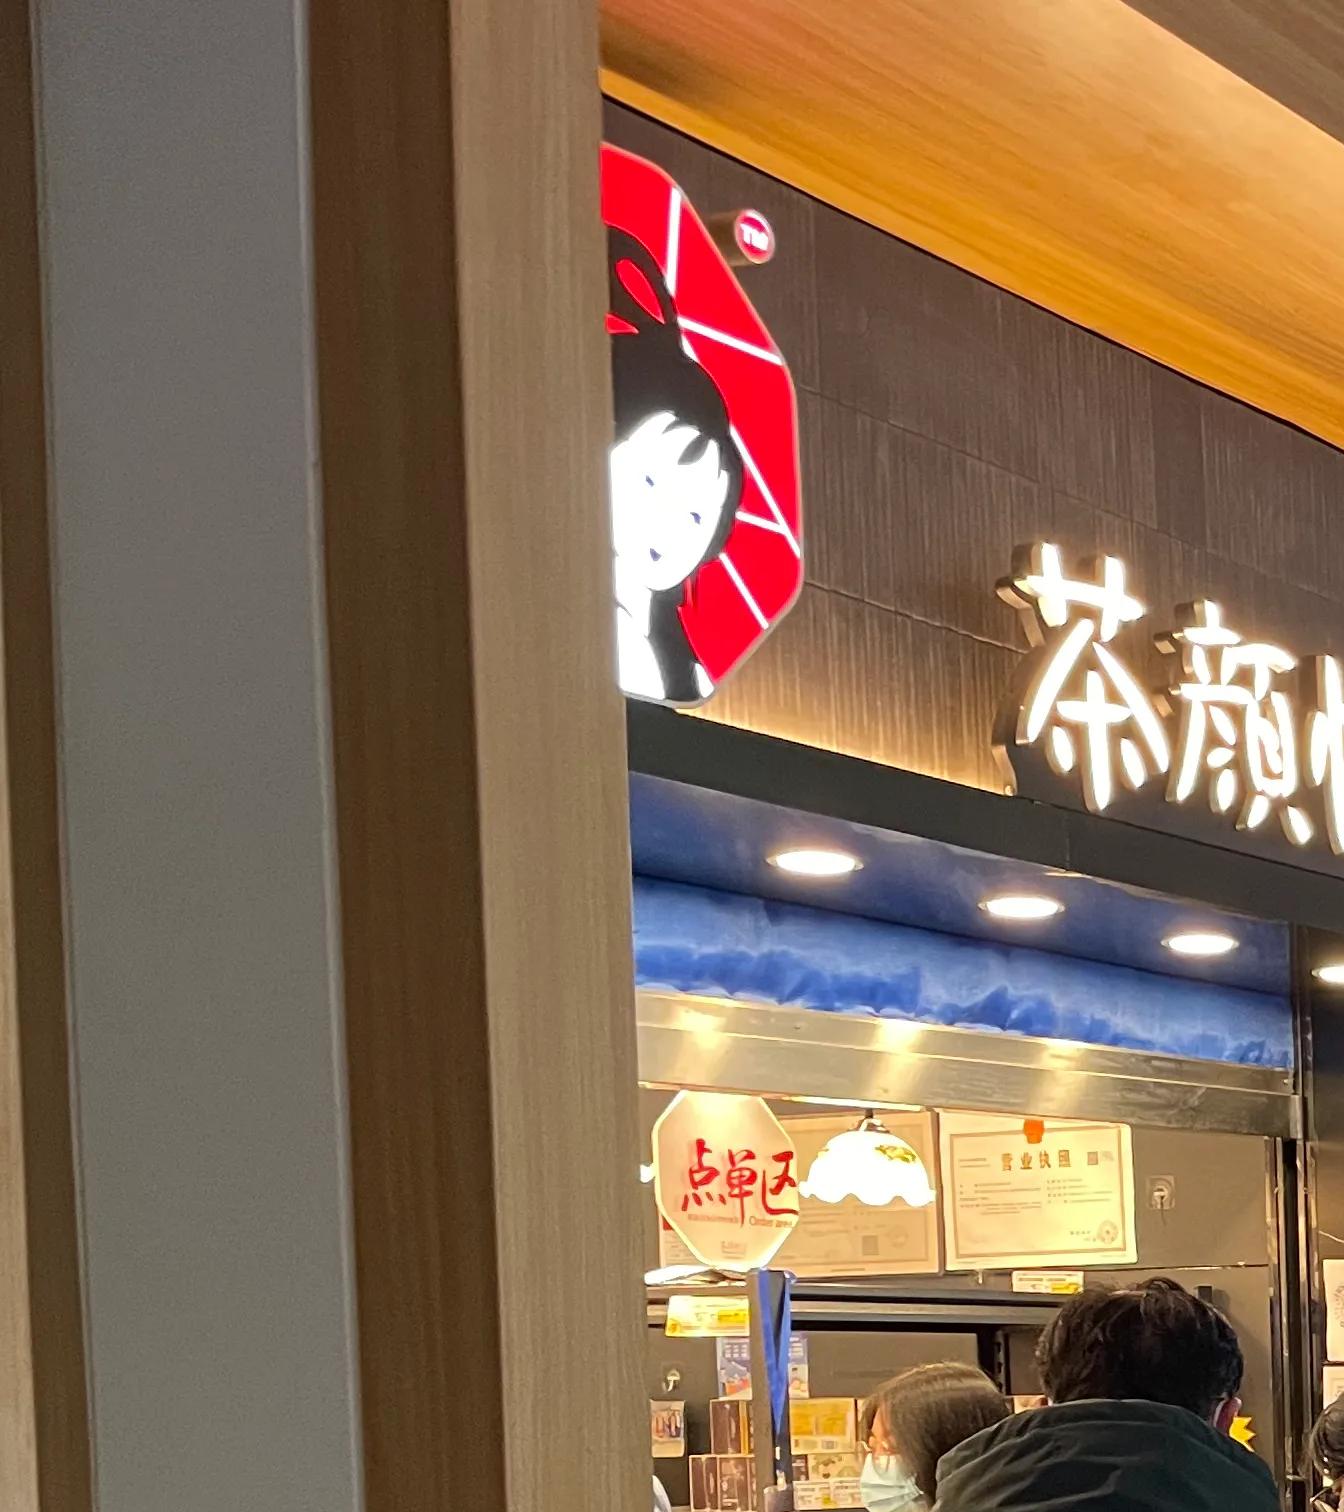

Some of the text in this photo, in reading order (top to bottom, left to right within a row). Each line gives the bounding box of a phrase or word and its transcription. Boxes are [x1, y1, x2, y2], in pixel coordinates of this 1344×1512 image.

[681, 1137, 800, 1228] 点单区
[1001, 1149, 1072, 1172] 营业执照
